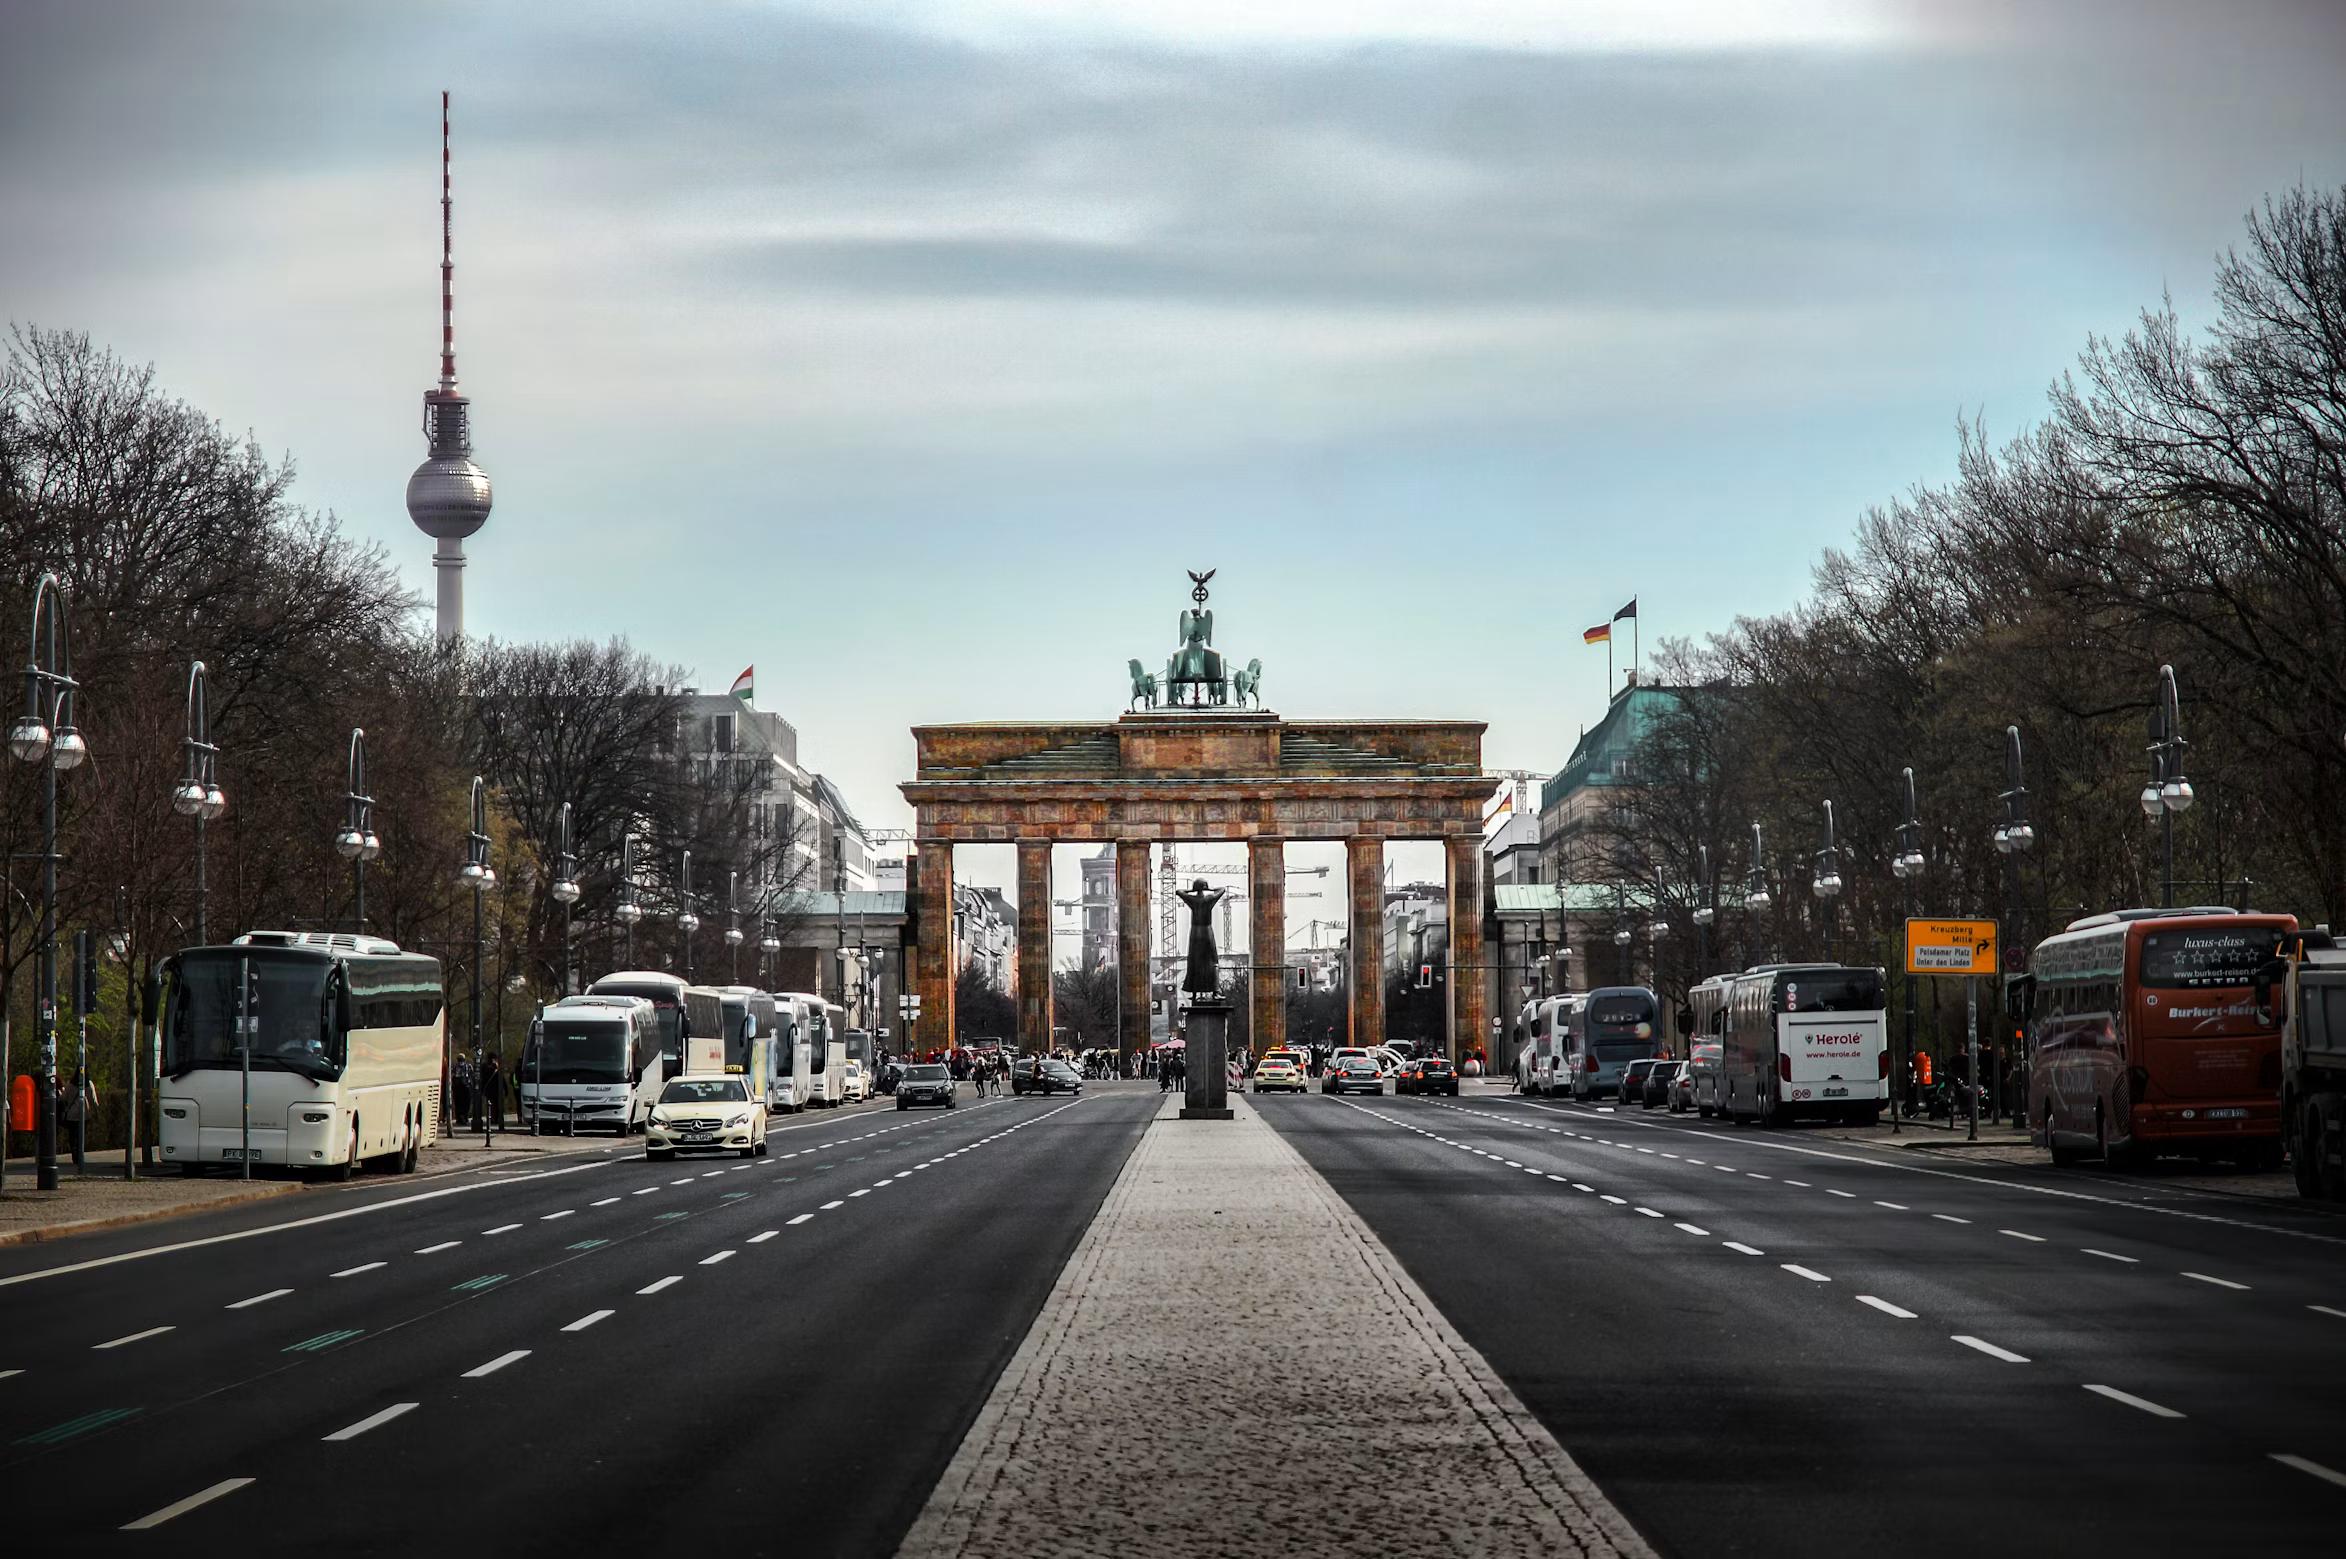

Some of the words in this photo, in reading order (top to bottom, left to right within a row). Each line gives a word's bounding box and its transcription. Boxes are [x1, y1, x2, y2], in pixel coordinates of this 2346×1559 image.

[1930, 925, 1973, 935] Kreuzberg
[1952, 935, 1973, 943] Mitte
[2184, 936, 2246, 948] luxus-class
[1919, 947, 1952, 956] Potsdamer
[1954, 947, 1970, 957] Platz
[1916, 958, 1933, 966] Unter
[1936, 958, 1948, 966] den
[1949, 958, 1970, 966] Linden
[1816, 1032, 1860, 1045] Herolé
[1806, 1051, 1861, 1059] www.herole.de
